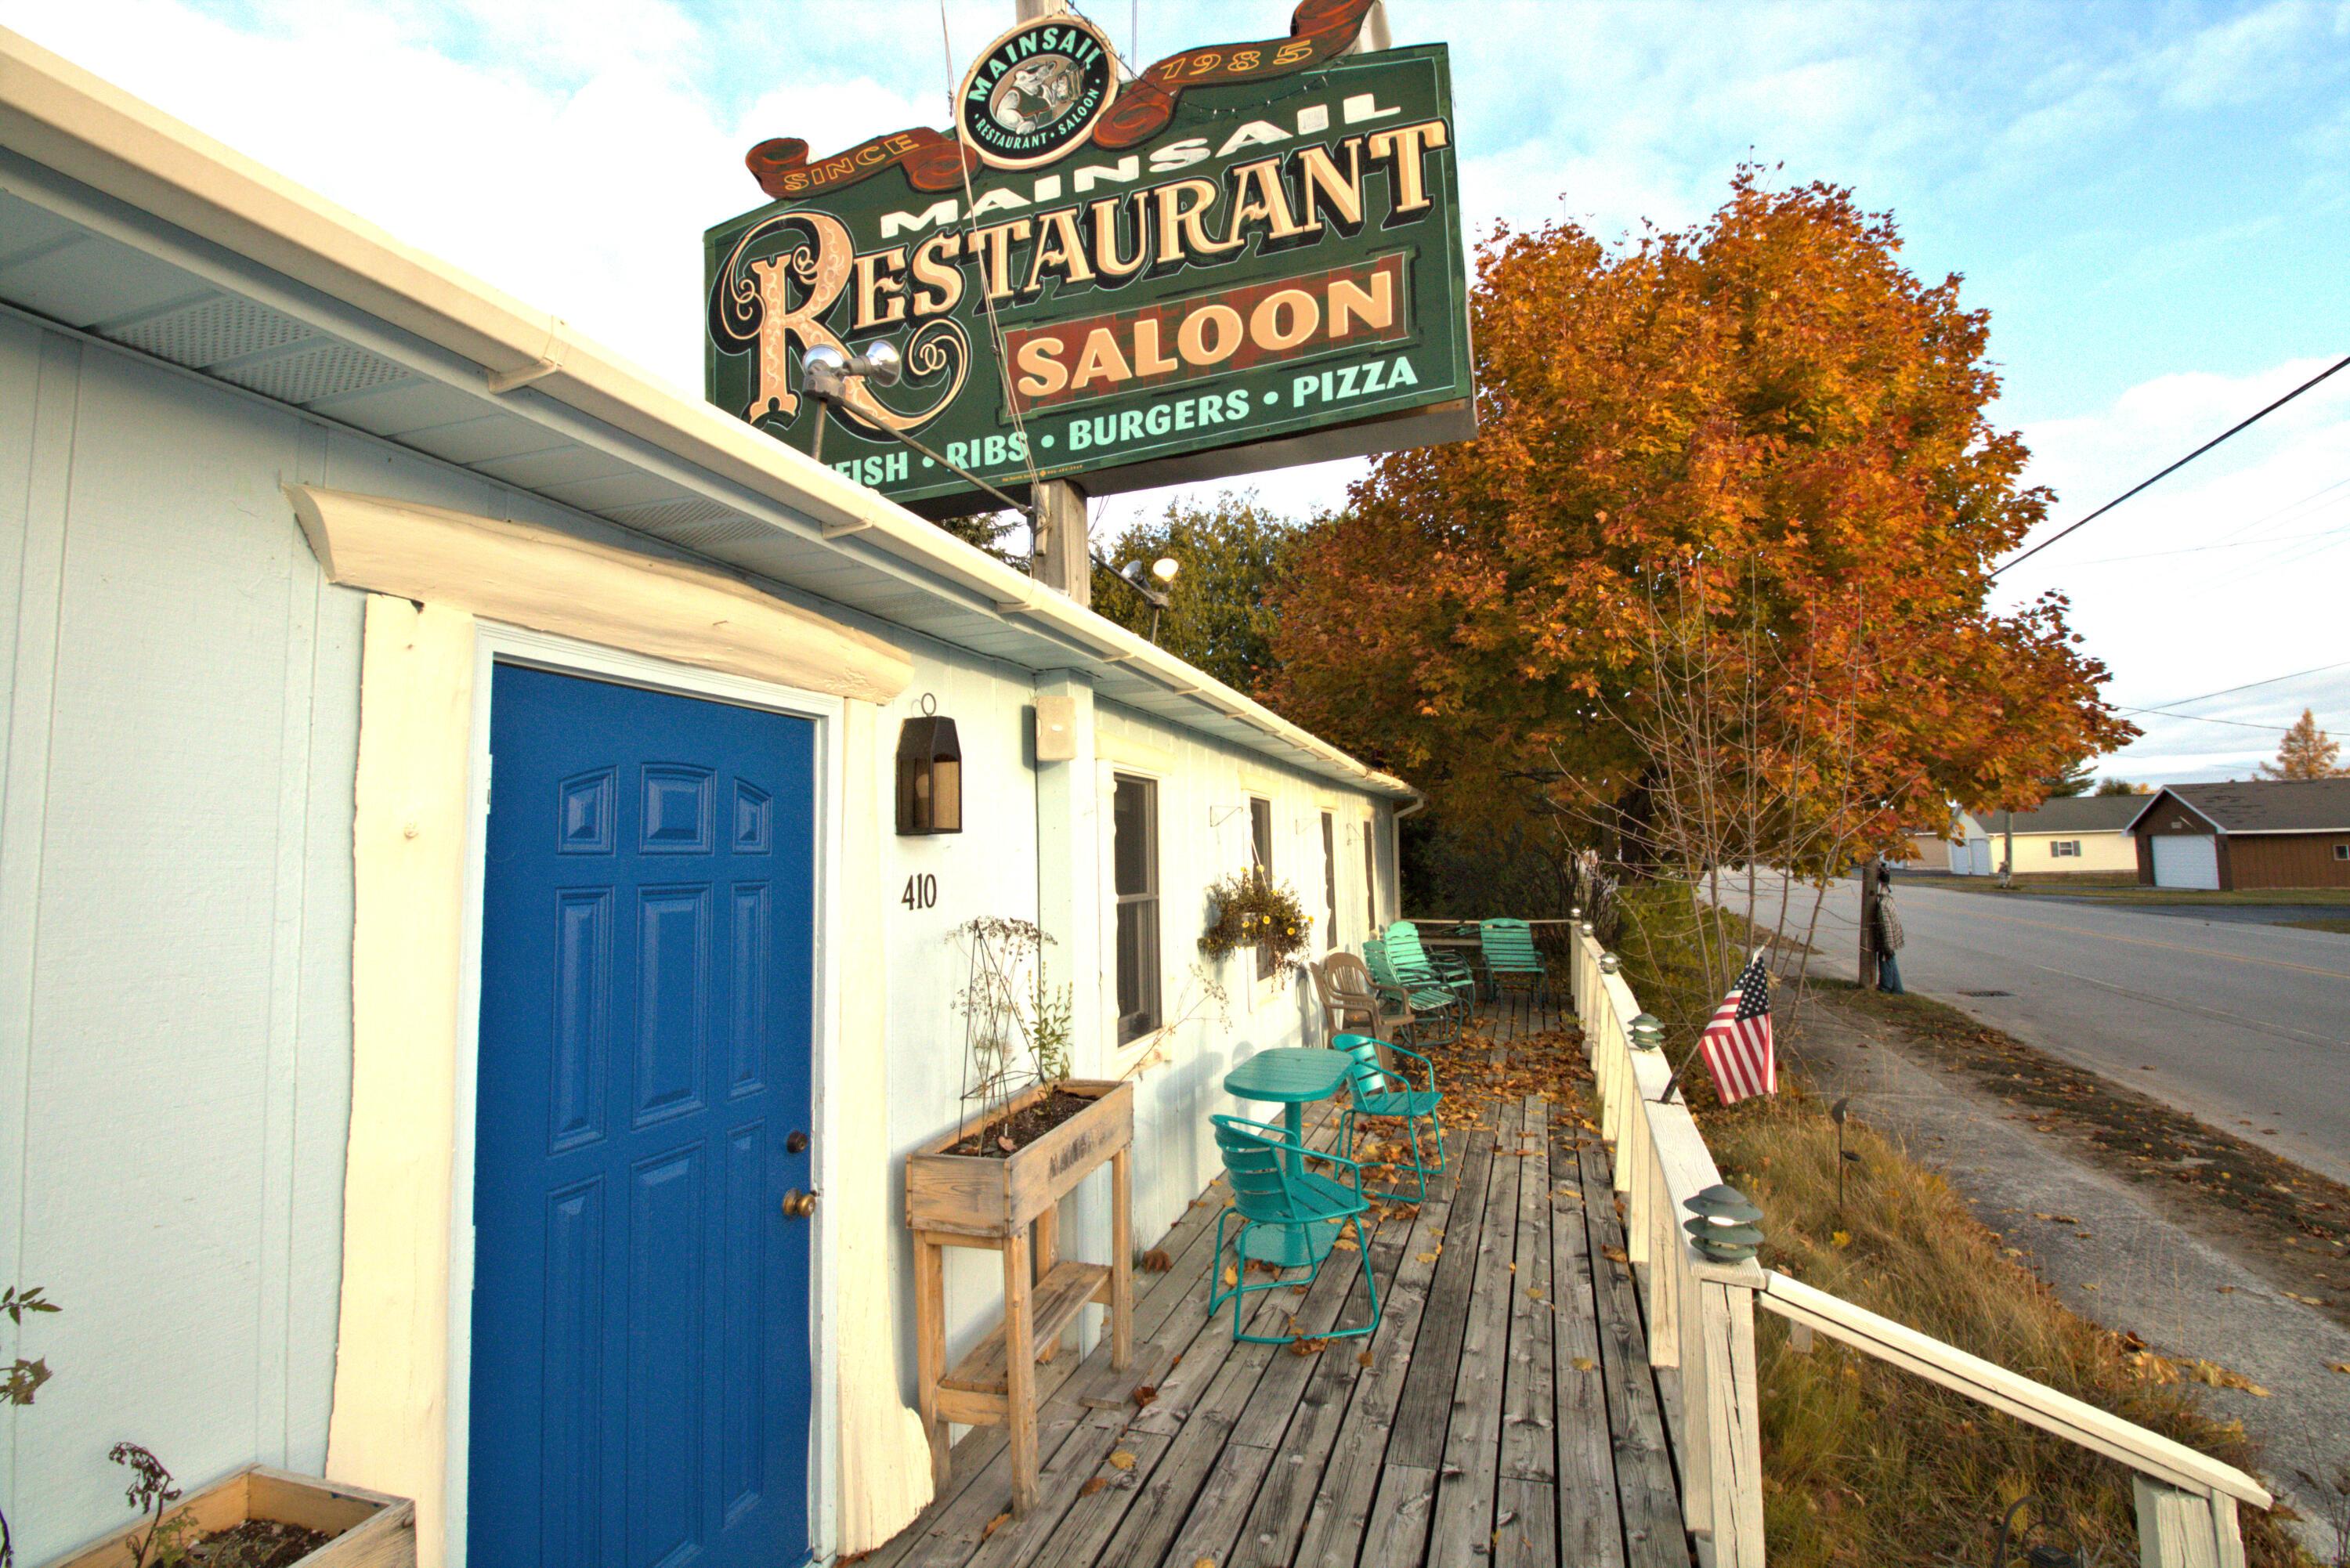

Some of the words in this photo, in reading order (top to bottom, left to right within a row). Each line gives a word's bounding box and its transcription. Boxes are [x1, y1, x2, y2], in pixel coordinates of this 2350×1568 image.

[968, 27, 1101, 102] MAINSAIL
[1160, 39, 1313, 80] 1985
[975, 118, 1047, 150] RESTAURANT
[1058, 88, 1100, 135] SALOON
[783, 133, 920, 193] SINCE
[880, 93, 1401, 239] MAINSAIL
[721, 120, 1448, 432] RESTAURANT
[1017, 269, 1393, 397] SALOON
[827, 451, 908, 486] FISH
[946, 431, 1029, 472] RIBS
[1068, 388, 1250, 452] BURGERS
[1292, 356, 1419, 408] PIZZA
[901, 873, 937, 910] 410
